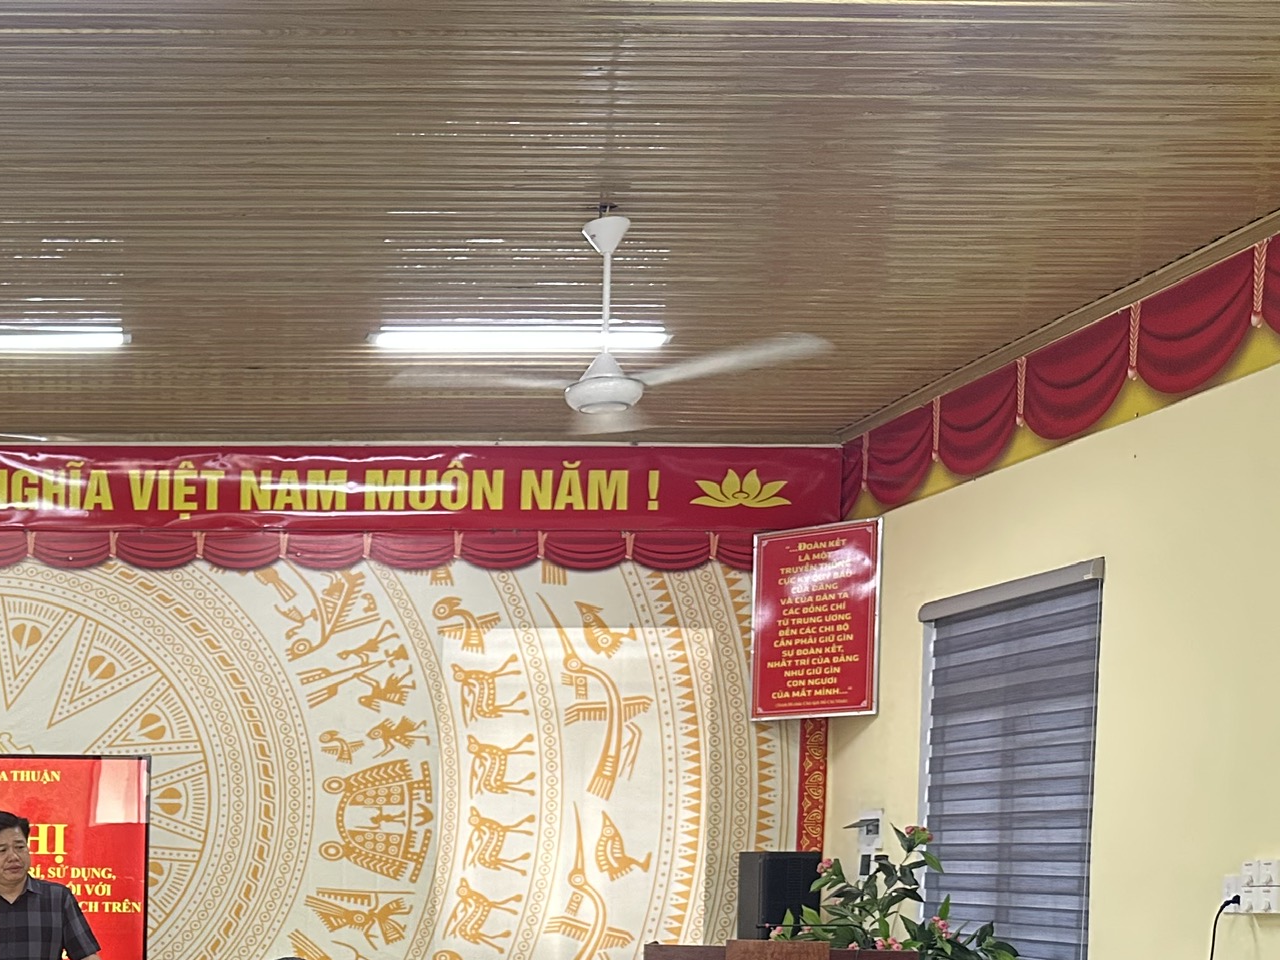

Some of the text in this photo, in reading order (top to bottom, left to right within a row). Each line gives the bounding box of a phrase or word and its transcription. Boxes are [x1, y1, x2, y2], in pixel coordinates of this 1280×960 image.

[128, 461, 226, 520] VIỆT
[240, 470, 349, 511] NAM
[364, 460, 504, 511] MUÔN
[521, 461, 629, 510] NĂM
[647, 470, 659, 510] !
[828, 538, 847, 547] KẾT
[780, 597, 793, 605] VÀ
[782, 606, 800, 615] CÁC
[830, 601, 846, 611] CHÍ
[791, 616, 822, 625] TRUNG
[825, 613, 852, 622] ƯƠNG
[778, 627, 797, 636] ĐẾN
[799, 626, 817, 634] CÁC
[836, 622, 849, 632] BỘ
[774, 633, 853, 647] CẦN PHẢI GIỮ GÌN
[796, 647, 822, 656] ĐOÀN
[767, 654, 859, 668] NHẤT TRÍ CỦA ĐẢNG
[784, 669, 804, 677] NHƯ
[806, 667, 822, 676] GIỮ
[807, 677, 837, 685] NGƯƠI
[772, 690, 790, 699] CỦA
[792, 688, 812, 697] MẮT
[11, 770, 61, 784] THUẬN
[48, 865, 68, 878] SỬ
[71, 867, 116, 881] DỤNG,
[86, 883, 111, 896] VỚI
[102, 899, 141, 913] TRÊN
